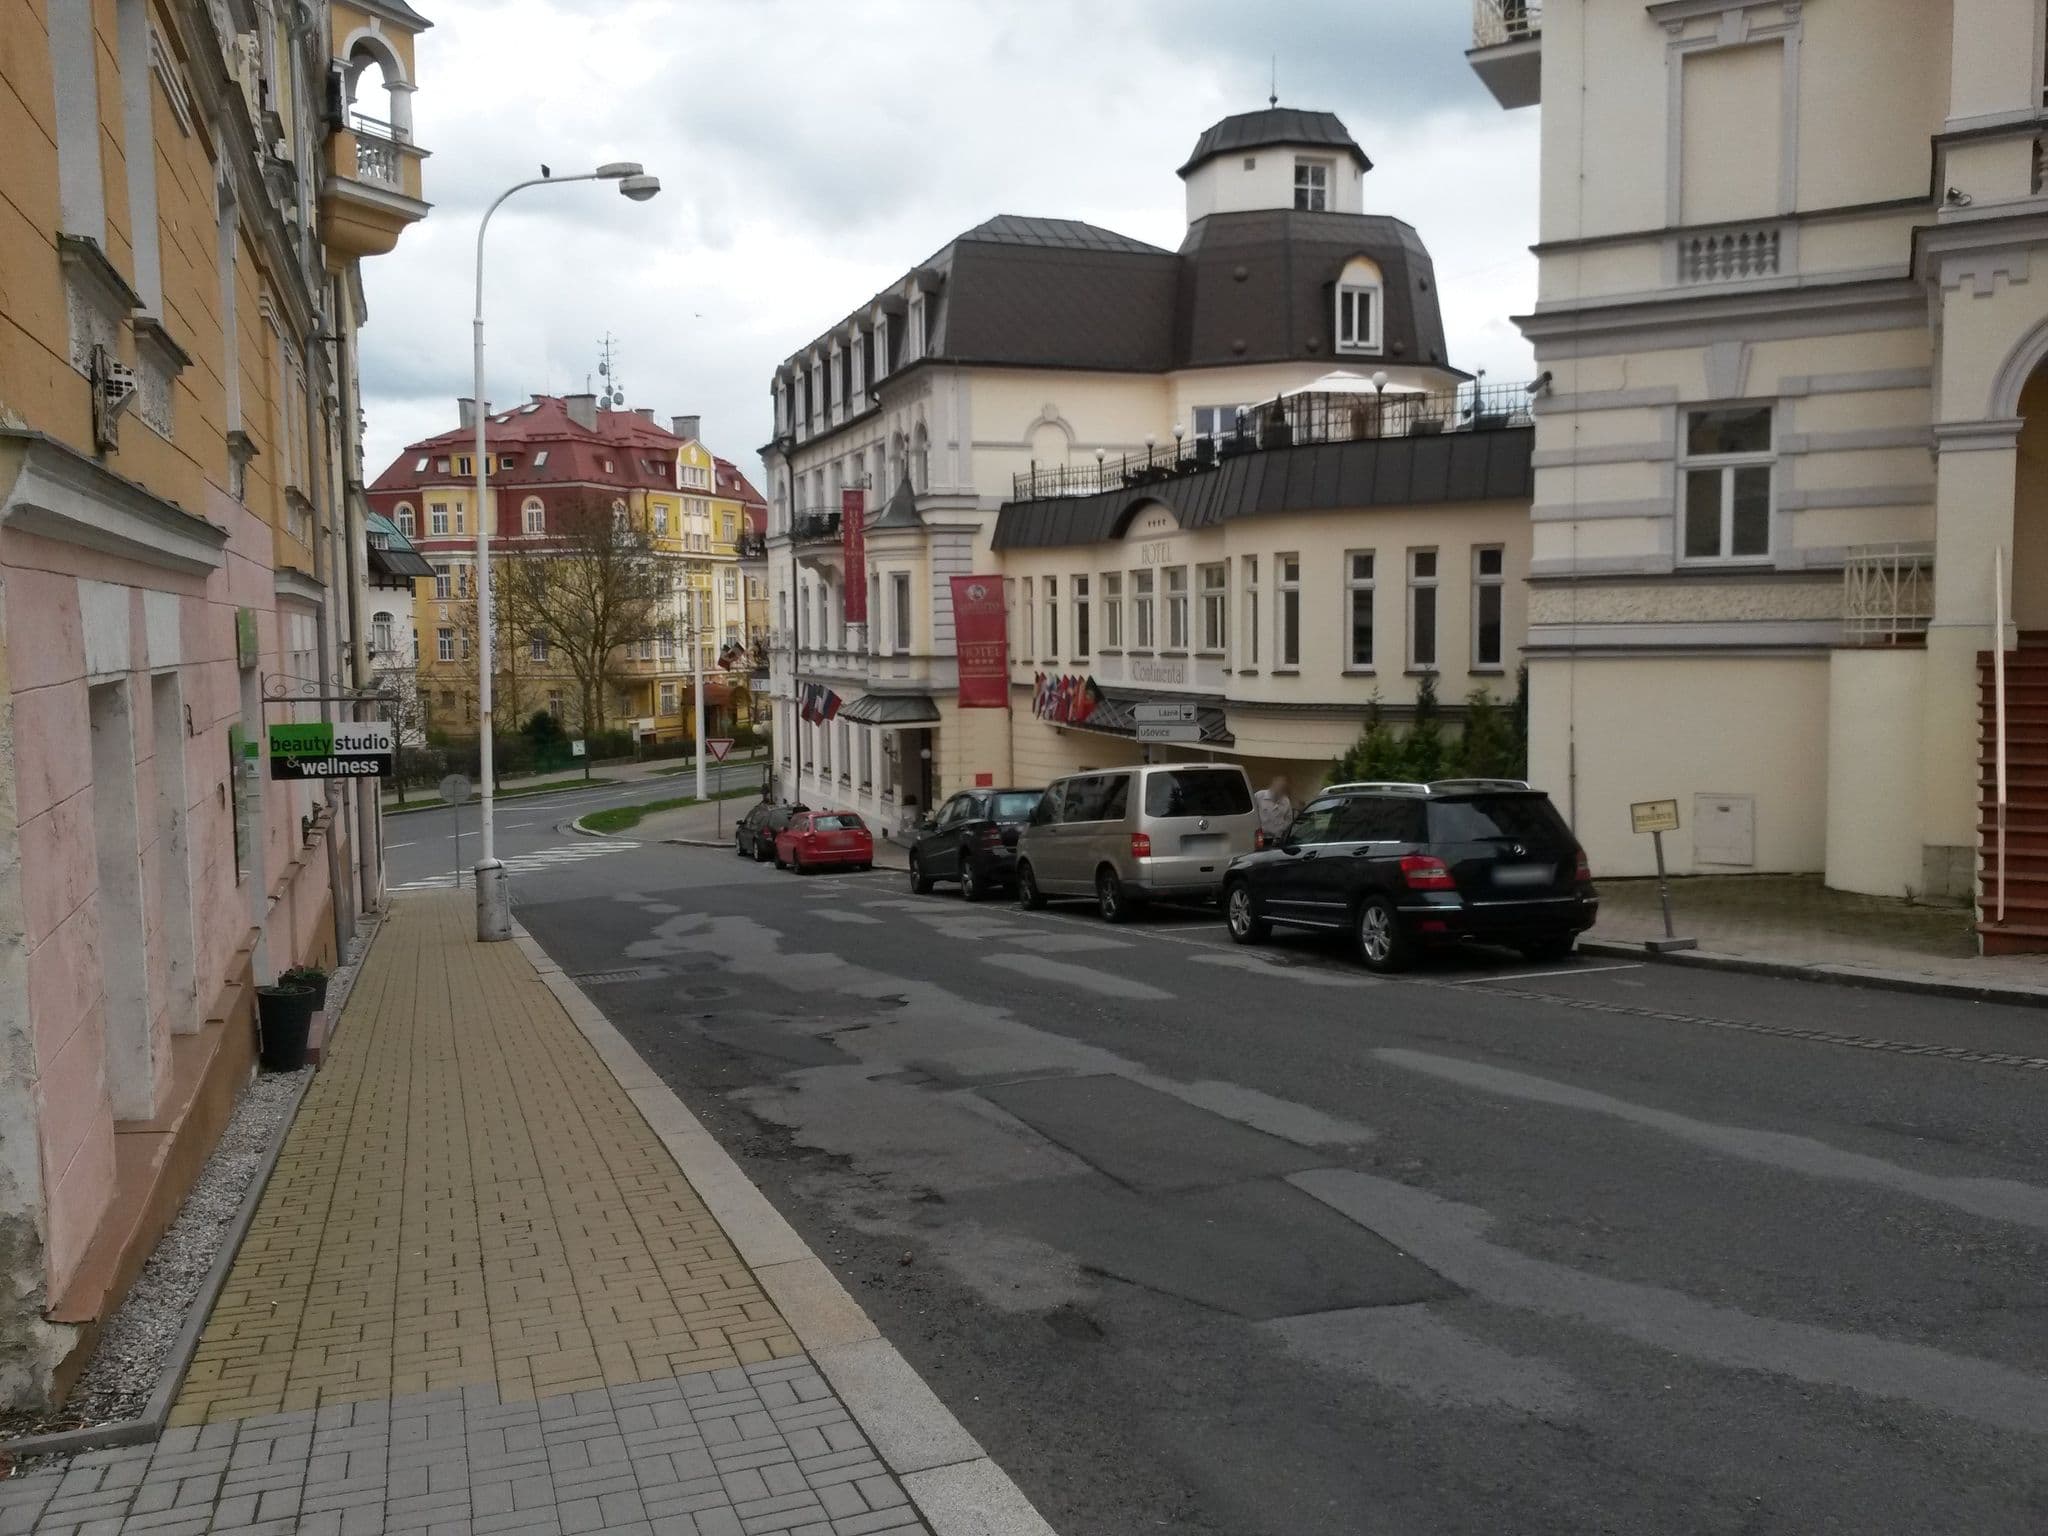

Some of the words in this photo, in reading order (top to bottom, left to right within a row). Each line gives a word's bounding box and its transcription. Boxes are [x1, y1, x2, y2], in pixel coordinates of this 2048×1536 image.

[1142, 542, 1172, 565] HOTEL
[960, 647, 1001, 658] HOTEL
[1133, 660, 1184, 684] Continental
[271, 736, 330, 754] beauty
[335, 734, 389, 750] studio
[287, 754, 300, 768] &
[301, 758, 379, 775] wellness
